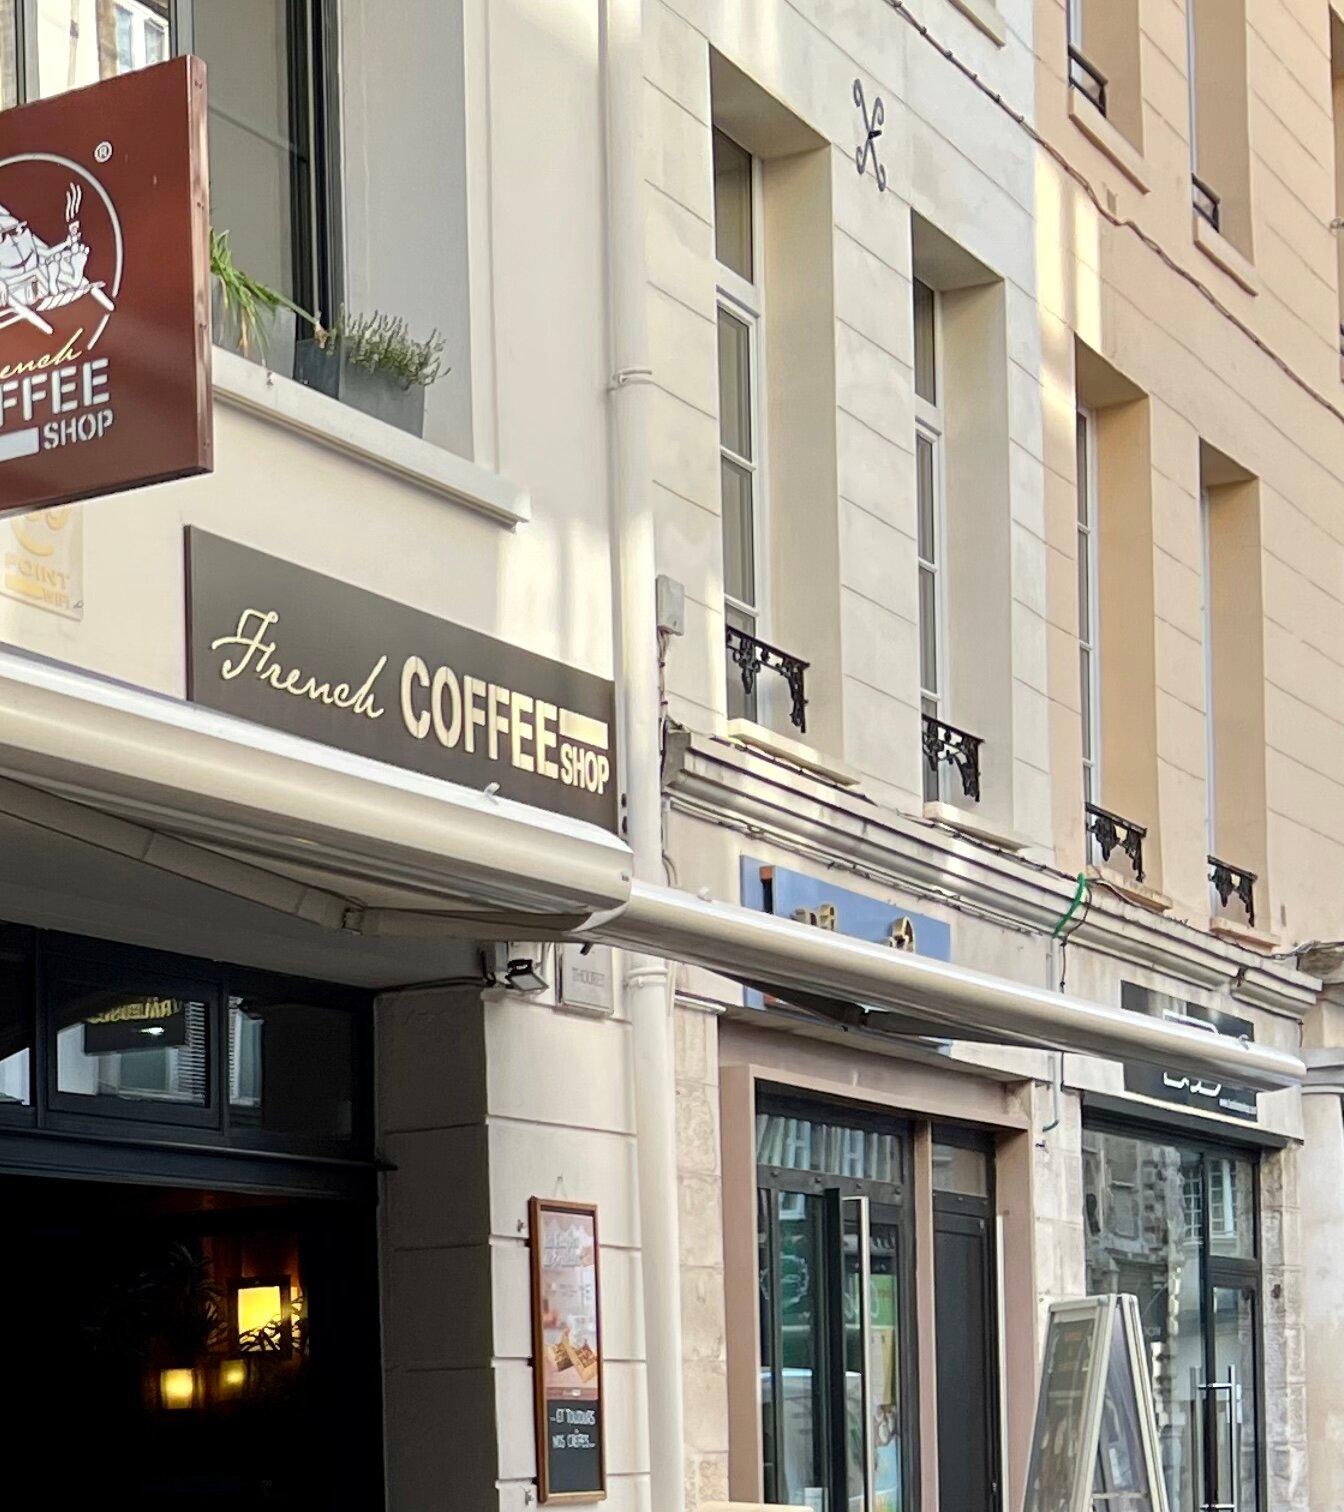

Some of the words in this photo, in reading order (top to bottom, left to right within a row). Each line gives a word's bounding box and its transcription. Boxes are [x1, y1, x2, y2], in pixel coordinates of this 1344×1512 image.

[43, 408, 114, 450] SHOP
[211, 609, 385, 720] French
[399, 655, 559, 781] COFFEE
[560, 742, 610, 795] SHOP
